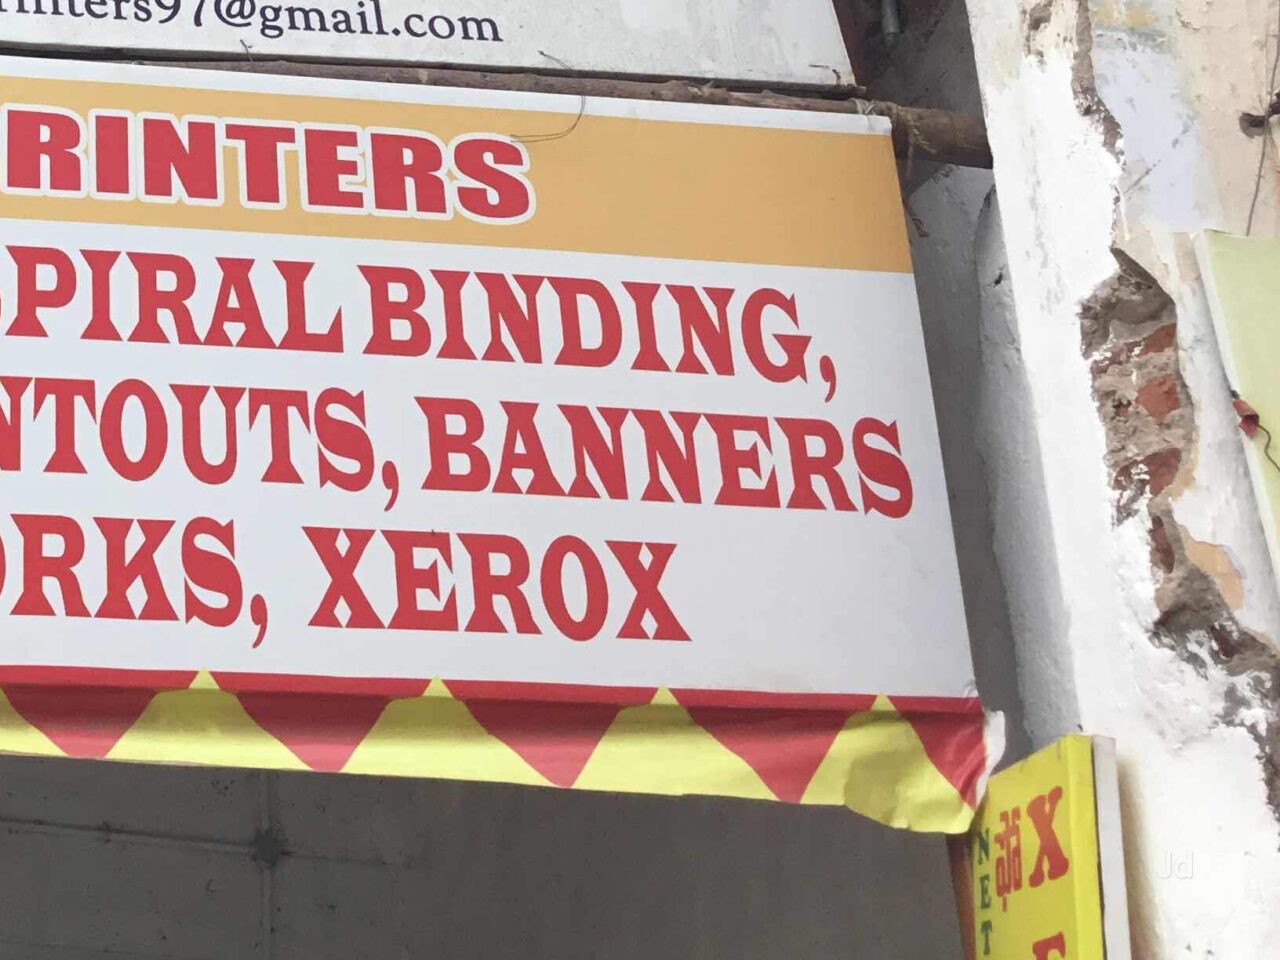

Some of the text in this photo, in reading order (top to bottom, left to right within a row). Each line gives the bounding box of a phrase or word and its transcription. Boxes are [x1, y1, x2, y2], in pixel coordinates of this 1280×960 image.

[358, 264, 838, 402] BINDING,
[417, 396, 915, 520] BANNERS
[303, 526, 690, 642] XEROX
